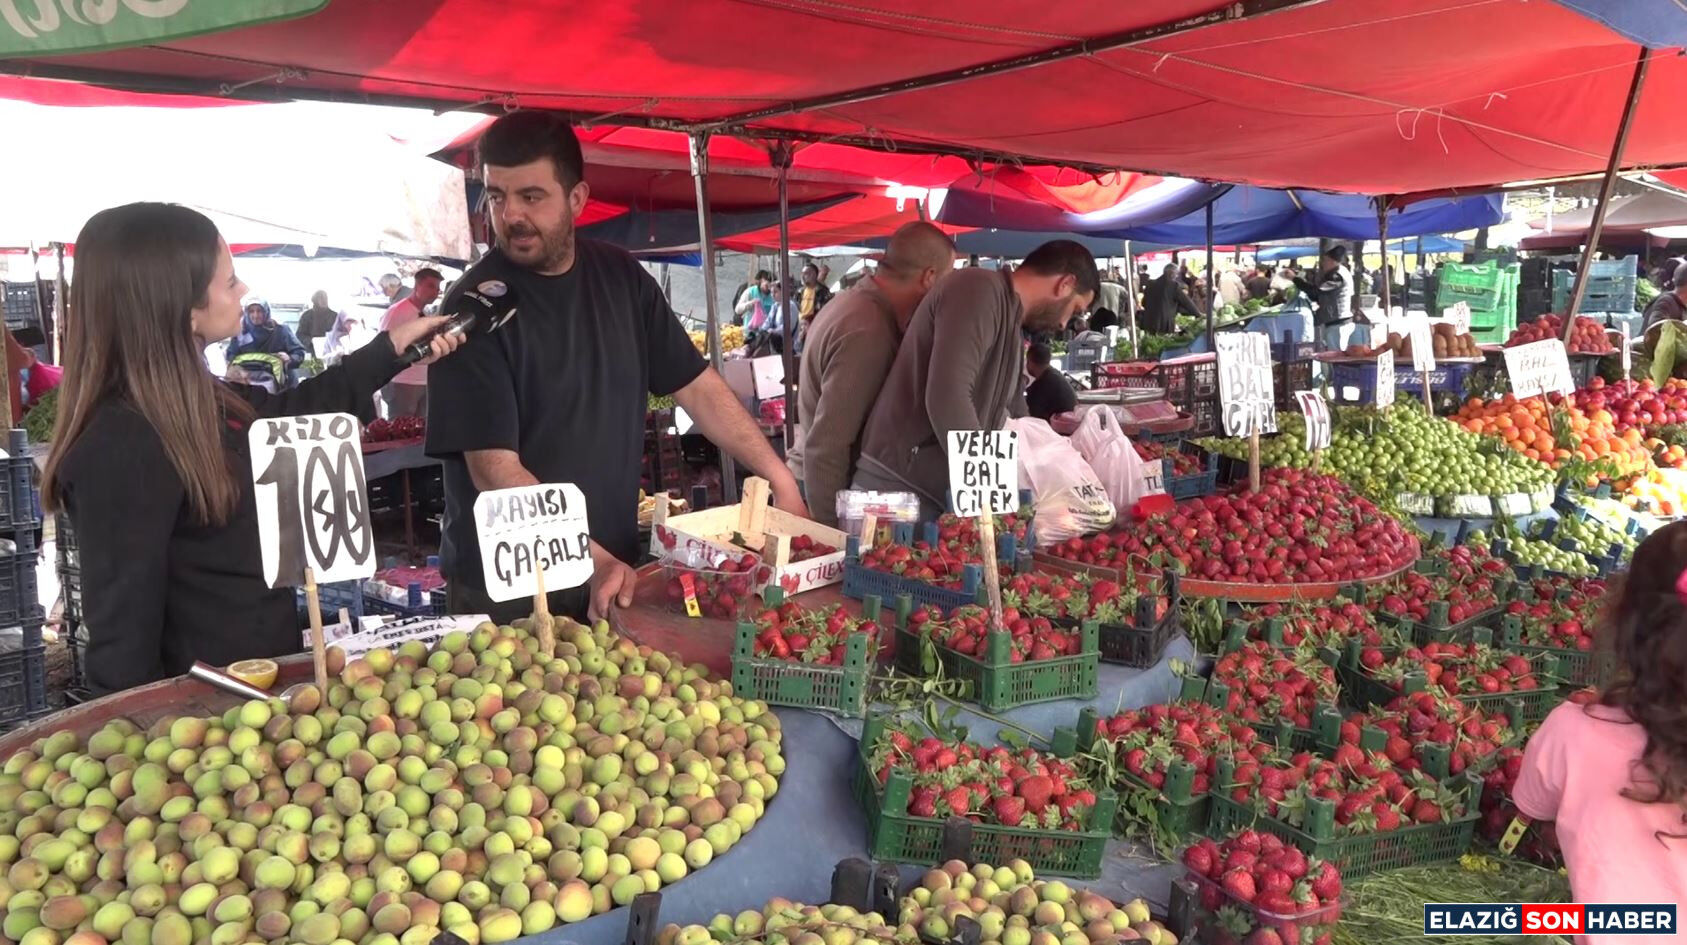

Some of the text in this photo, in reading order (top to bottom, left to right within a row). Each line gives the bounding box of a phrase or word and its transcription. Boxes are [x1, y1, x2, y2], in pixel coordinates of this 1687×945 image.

[266, 416, 353, 446] KİLO
[956, 431, 1017, 460] YERLİ
[964, 460, 1007, 490] BAL
[254, 441, 372, 589] 100
[486, 489, 568, 528] KAYISI
